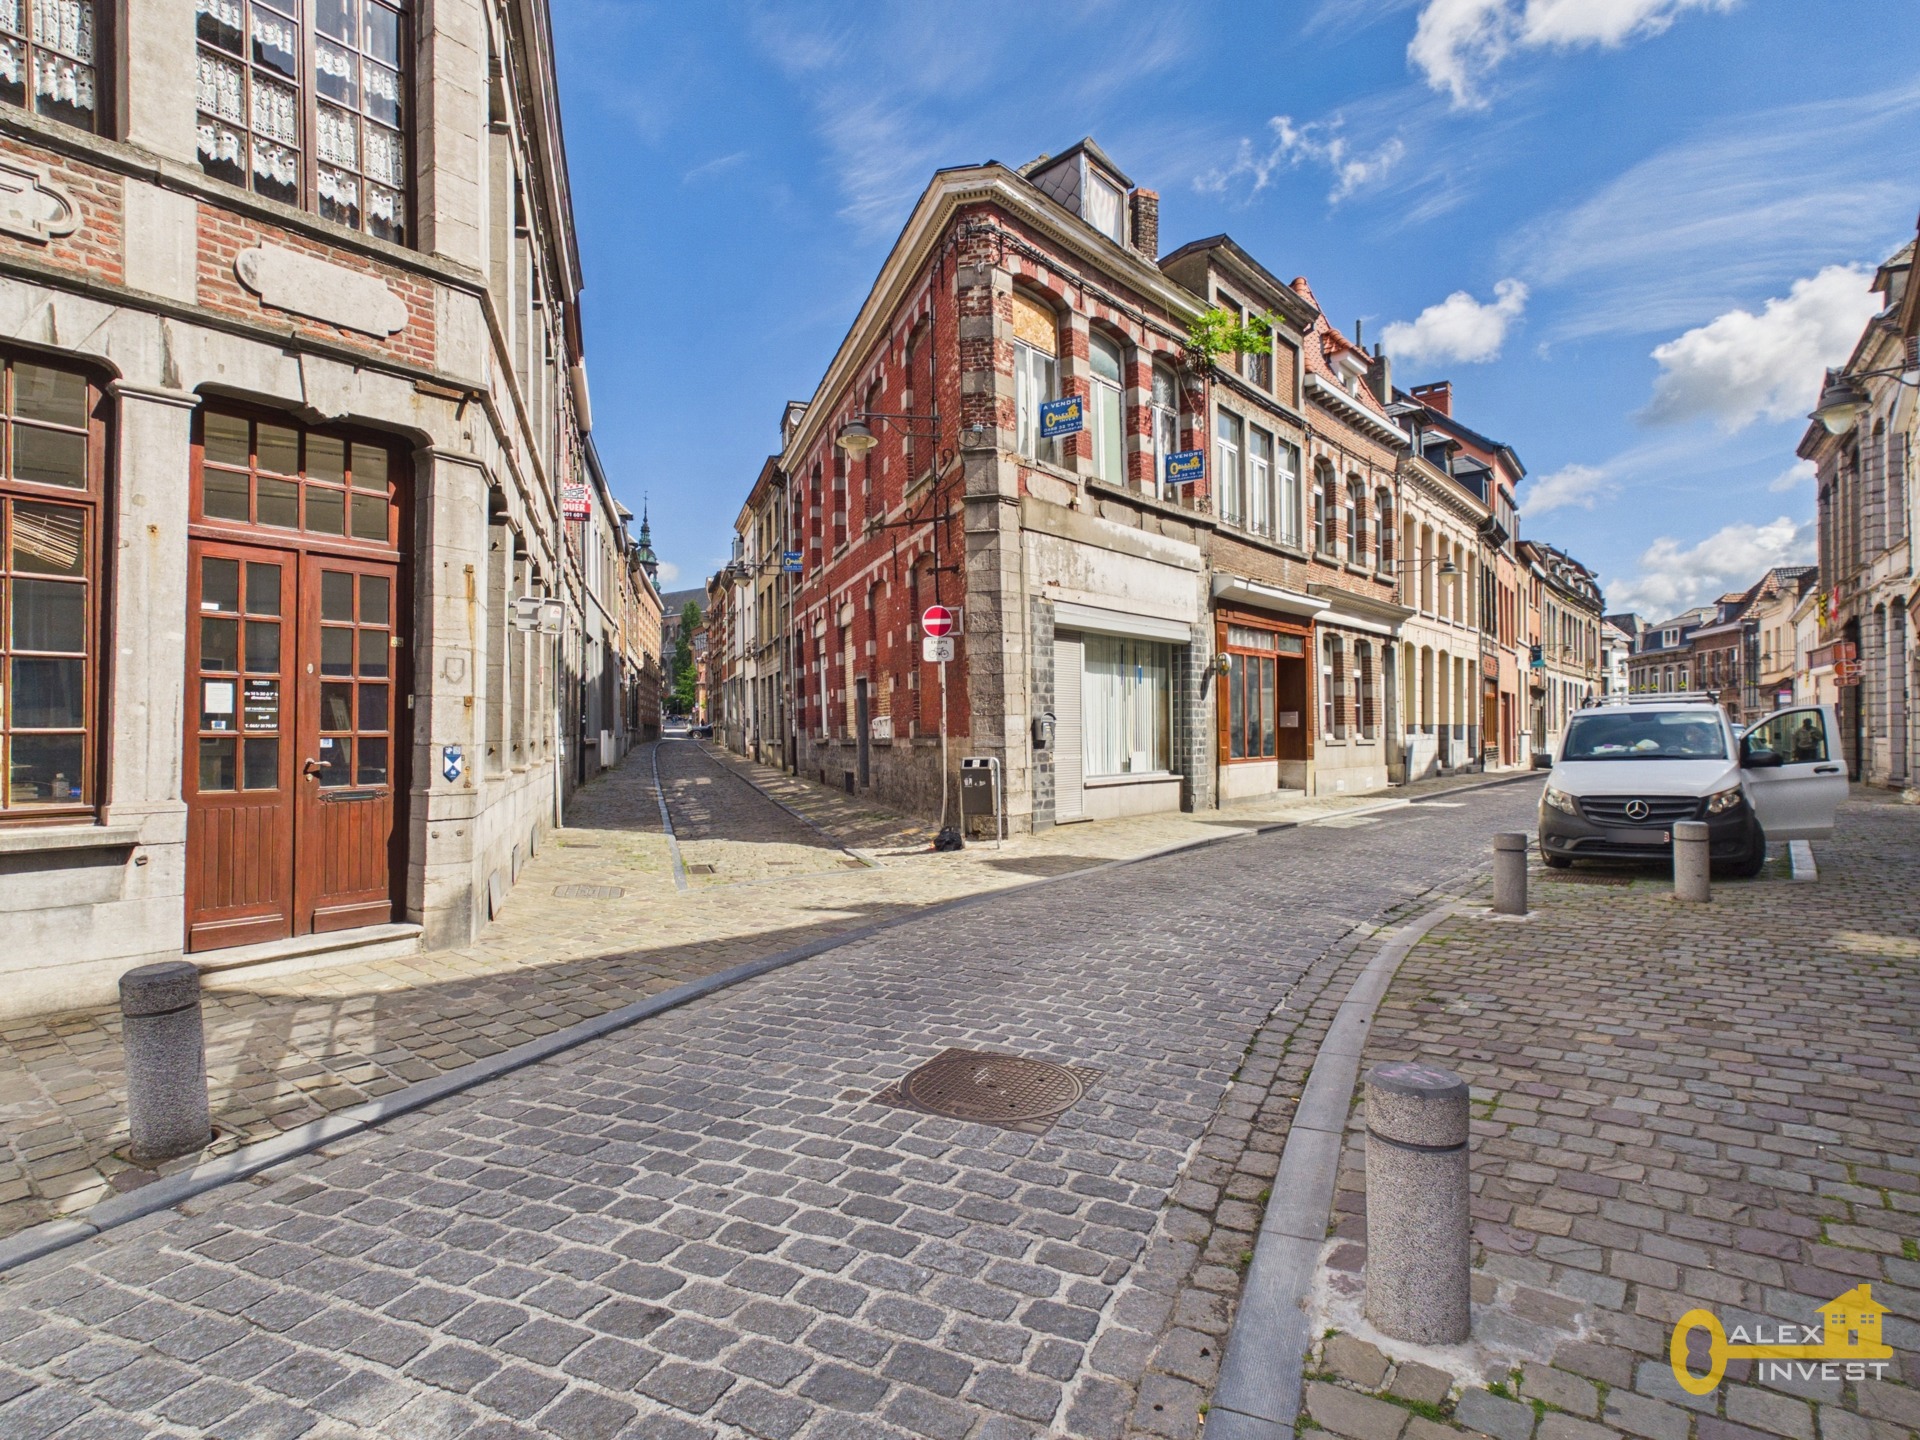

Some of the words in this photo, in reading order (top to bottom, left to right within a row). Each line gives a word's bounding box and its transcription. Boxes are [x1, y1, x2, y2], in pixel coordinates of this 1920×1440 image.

[1051, 397, 1082, 408] VENDRE
[1175, 451, 1203, 459] VENDRE
[563, 503, 585, 511] OUER
